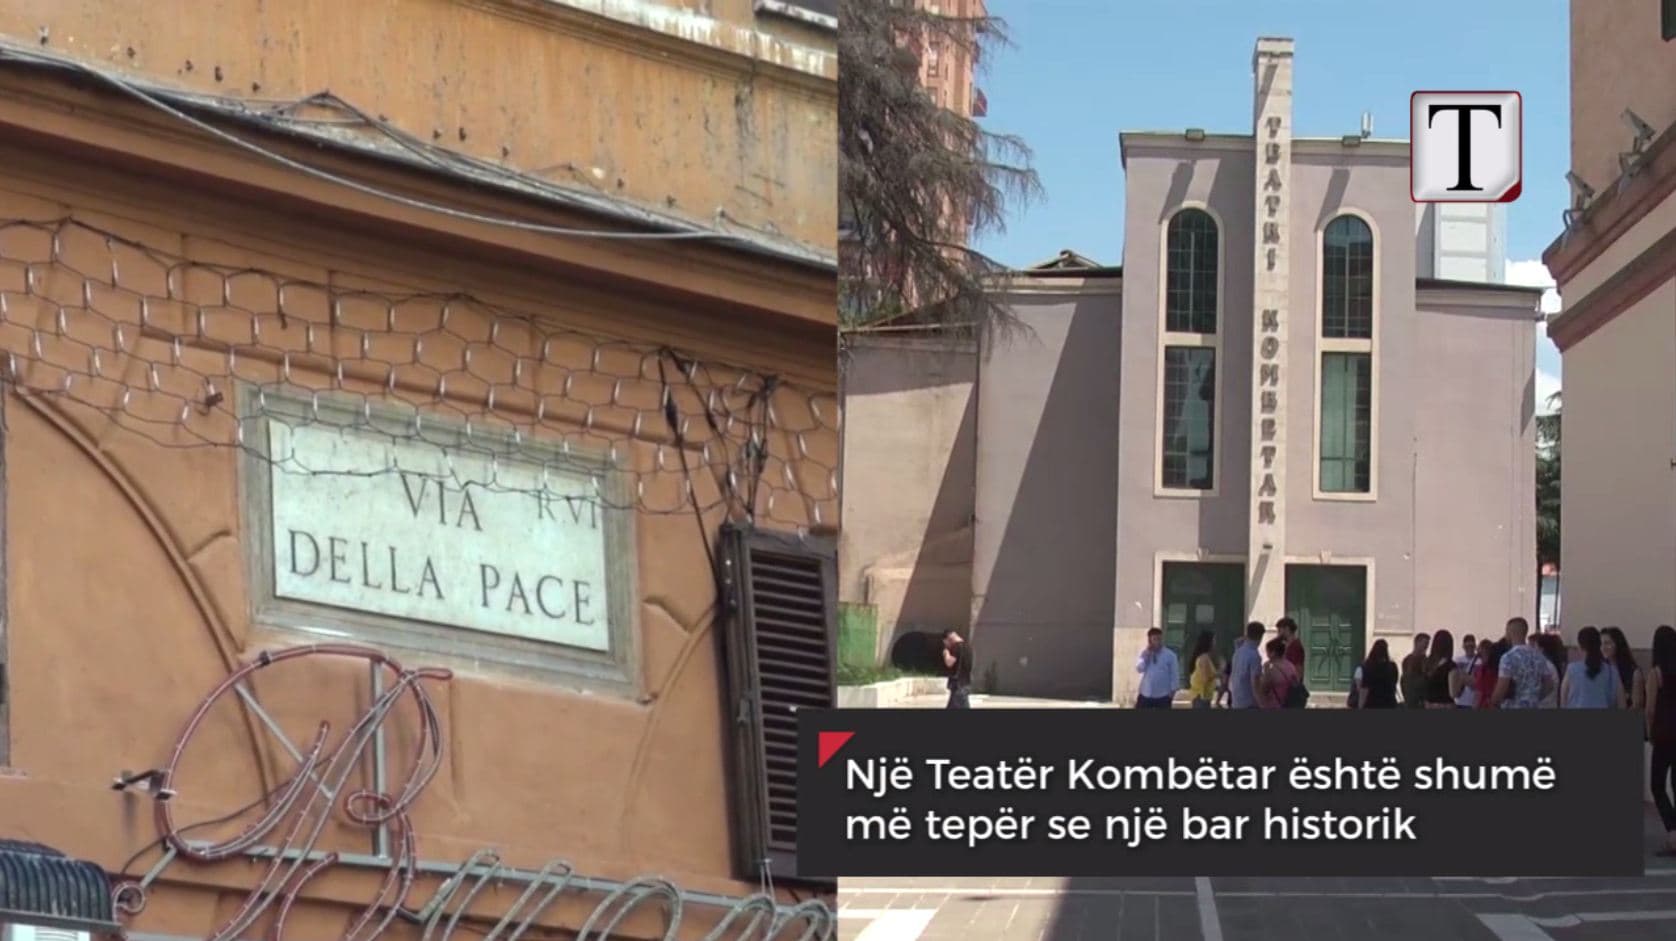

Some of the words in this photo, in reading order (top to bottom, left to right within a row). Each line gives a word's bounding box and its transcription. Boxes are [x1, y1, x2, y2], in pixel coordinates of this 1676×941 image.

[1262, 116, 1282, 272] TEATRI
[1257, 309, 1280, 525] KOMBETAR
[400, 472, 482, 531] VIA
[288, 529, 445, 600] DELLA
[479, 563, 595, 626] PACE
